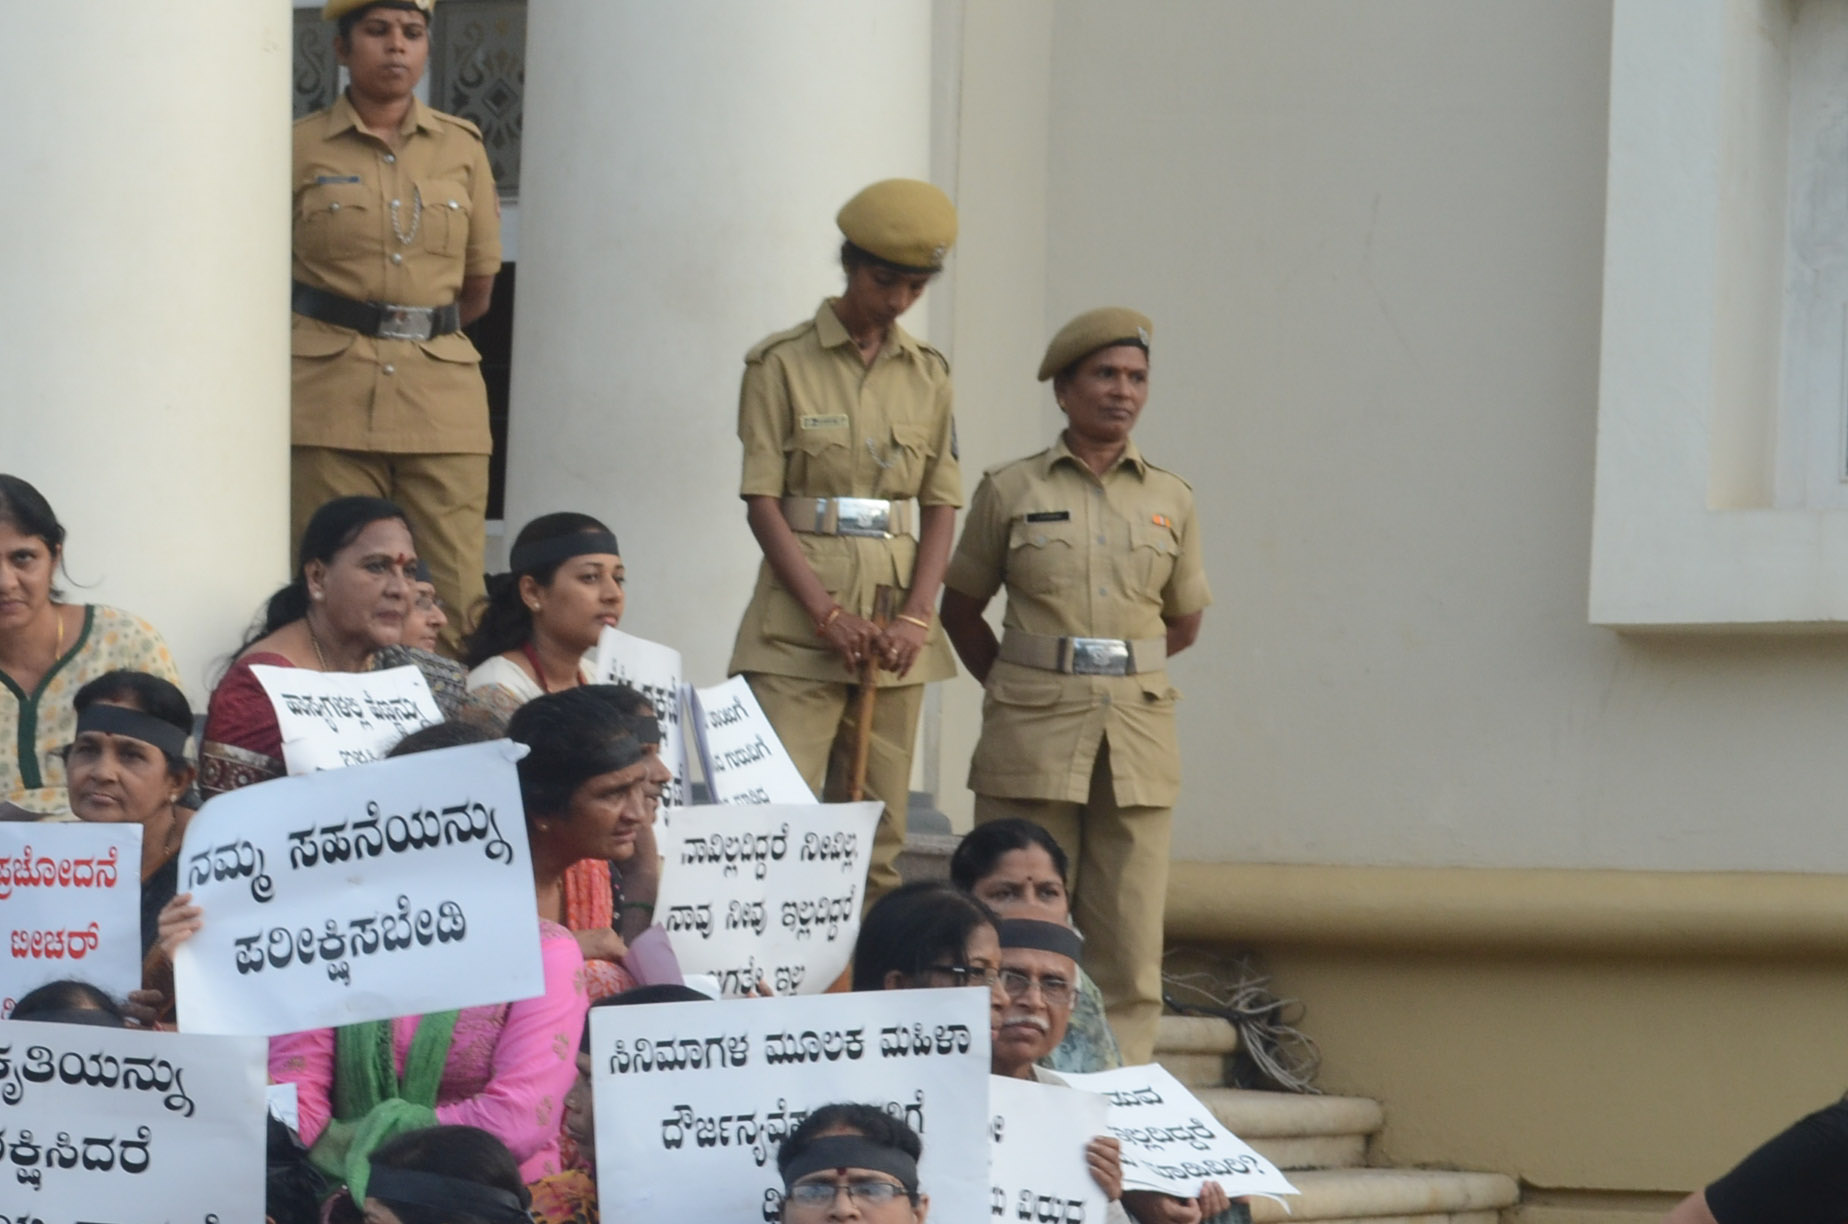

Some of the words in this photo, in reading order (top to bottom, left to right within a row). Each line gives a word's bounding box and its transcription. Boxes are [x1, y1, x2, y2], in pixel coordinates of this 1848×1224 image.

[187, 838, 275, 903] ನಮ್ಮ
[287, 797, 514, 866] ಸಹನೆಯನ್ನು
[10, 922, 99, 960] ಟೀಚರ್
[234, 895, 467, 986] ಪರೀಕ್ಷಿಸಬೇಡಿ
[609, 1035, 750, 1075] ಸಿನಿಮಾಗಳ
[765, 1028, 866, 1065] ಮೂಲಕ
[881, 1022, 971, 1058] ಮಹಿಳಾ
